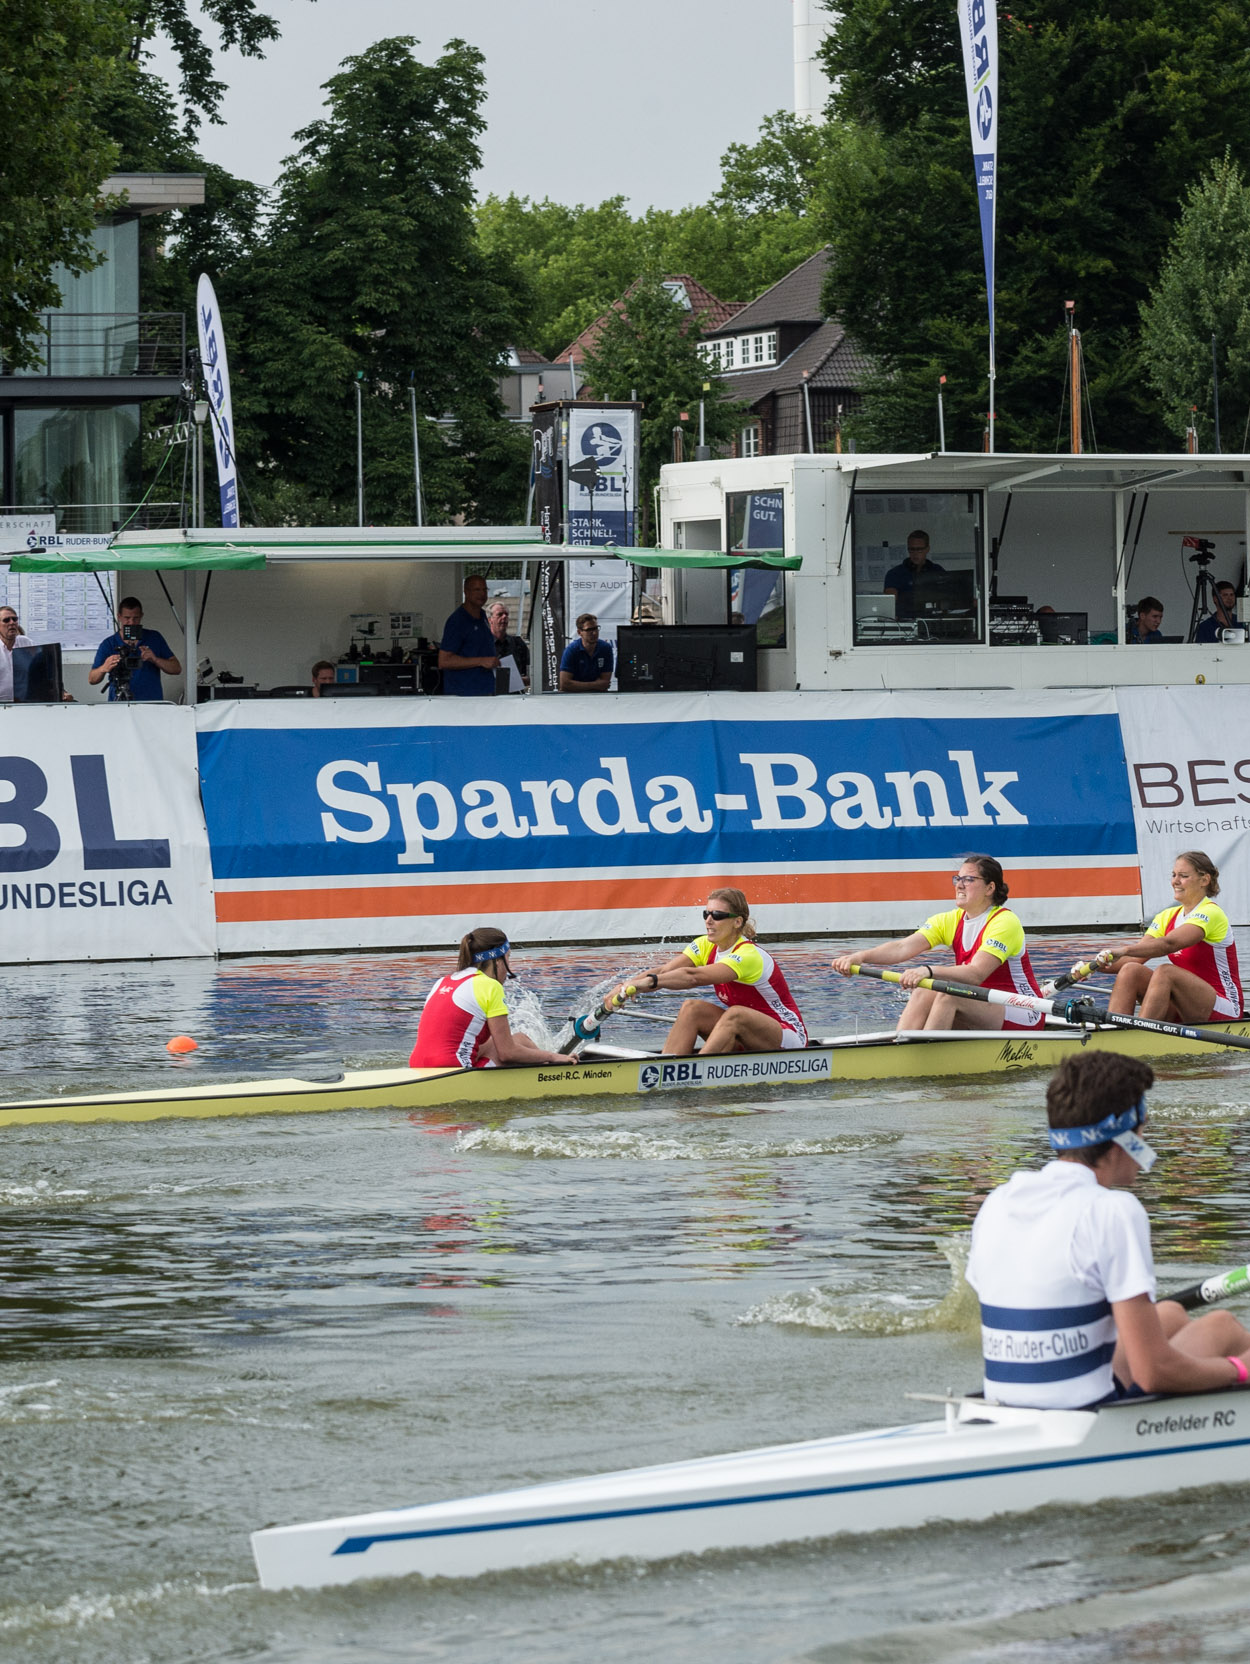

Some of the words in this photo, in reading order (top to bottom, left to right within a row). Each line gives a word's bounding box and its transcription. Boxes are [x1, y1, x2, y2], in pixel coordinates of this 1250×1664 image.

[753, 510, 776, 521] GUT.
[40, 536, 63, 545] RBL
[572, 529, 616, 537] SCHNELL.
[316, 751, 1028, 865] Sparda-Bank
[994, 940, 1008, 952] RBL
[1006, 996, 1036, 1010] Melitta
[1112, 1015, 1133, 1026] STARK.
[1134, 1019, 1162, 1031] SCHNELL.
[1163, 1025, 1178, 1034] GUT.
[1185, 1029, 1198, 1037] RBL
[996, 1040, 1034, 1063] Melitta
[538, 1071, 580, 1082] Bessel-R.C.
[583, 1070, 612, 1079] Minden
[662, 1064, 702, 1082] RBL
[707, 1058, 828, 1080] RUDER-BUNDESLIGA
[1050, 1131, 1071, 1146] NK
[1005, 1330, 1088, 1359] Ruder-Club
[1136, 1415, 1209, 1436] Crefelder
[1213, 1410, 1236, 1427] RC
